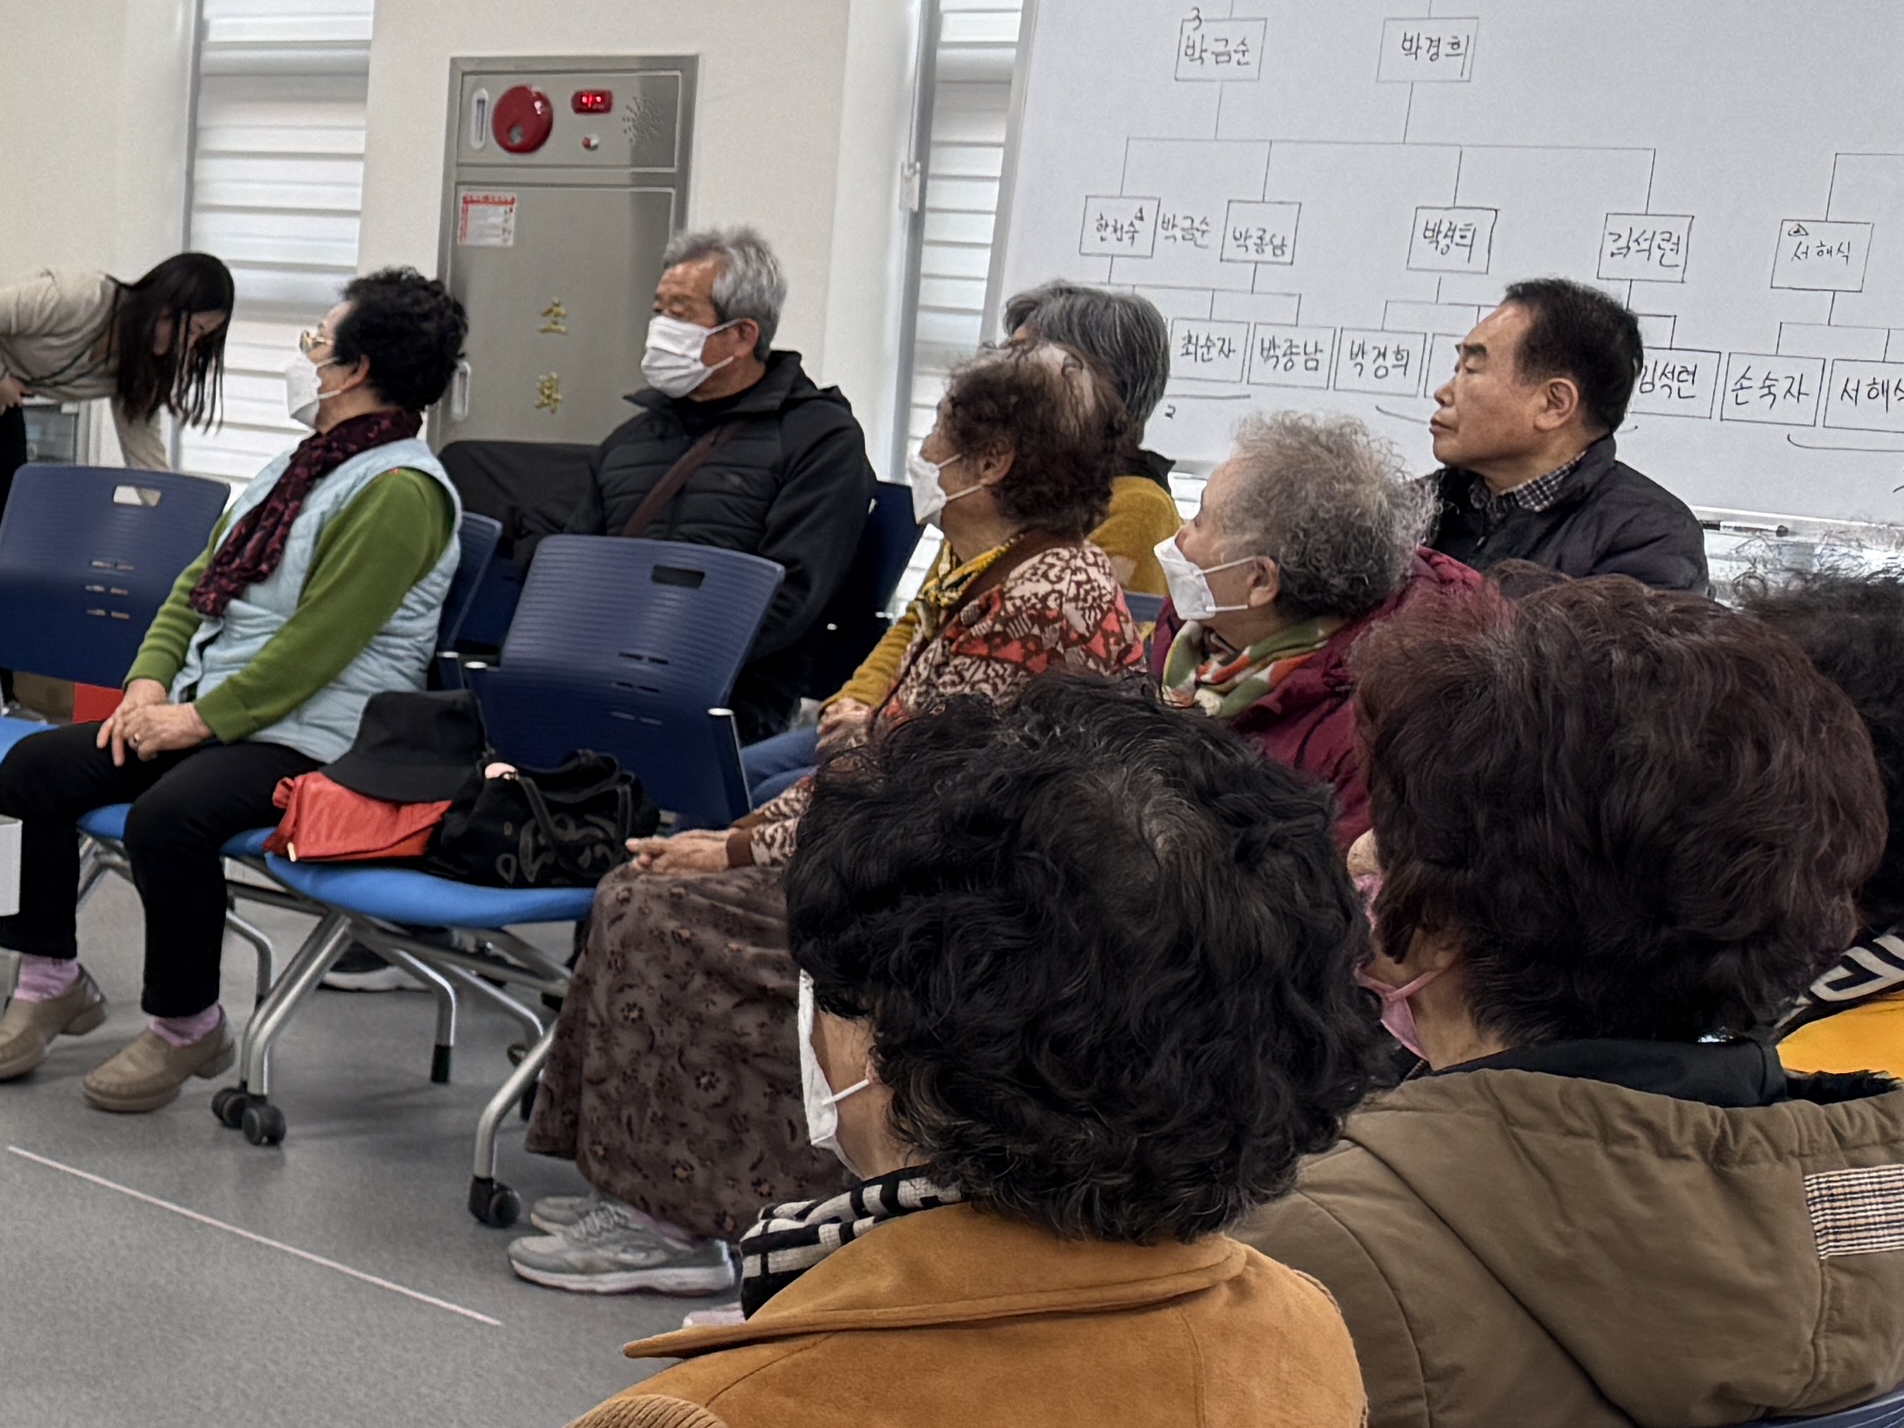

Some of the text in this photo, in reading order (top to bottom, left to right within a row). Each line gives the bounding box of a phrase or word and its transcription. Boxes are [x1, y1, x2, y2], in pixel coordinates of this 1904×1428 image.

[1191, 6, 1202, 31] 3
[1184, 33, 1250, 66] 박금순
[1401, 31, 1470, 78] 박경희
[1790, 239, 1851, 266] 서해식
[1731, 364, 1810, 410] 손숙자
